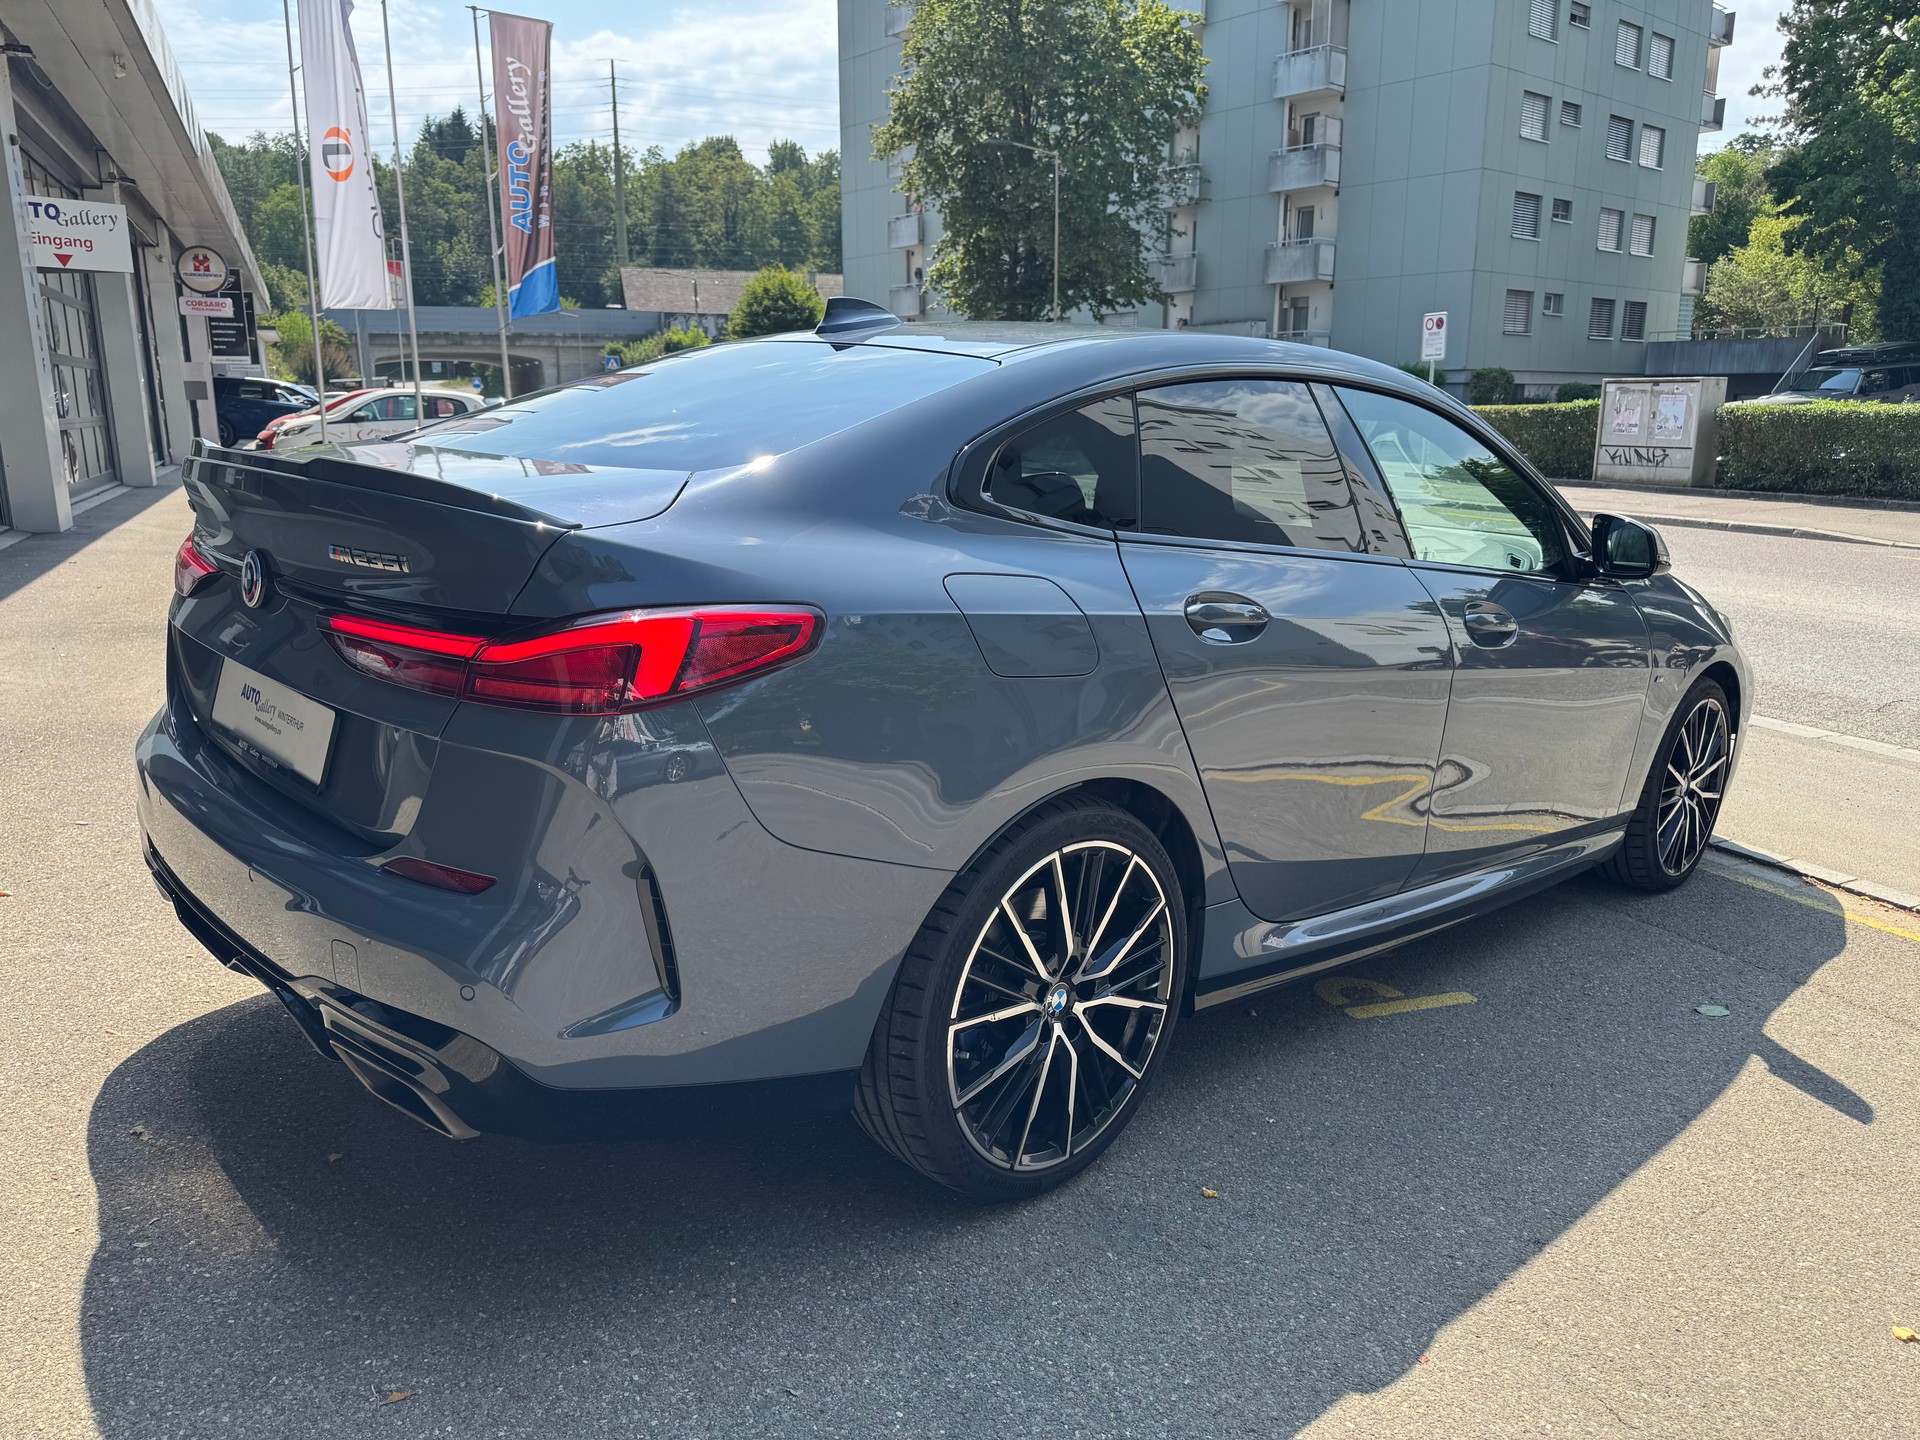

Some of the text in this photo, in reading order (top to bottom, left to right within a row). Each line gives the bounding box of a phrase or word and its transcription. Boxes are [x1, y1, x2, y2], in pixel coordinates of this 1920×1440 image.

[505, 55, 538, 235] AUTO Gallery
[28, 201, 118, 232] TO Gallery
[31, 231, 93, 252] Eingang
[185, 299, 227, 309] CORSARO
[333, 545, 410, 573] M235i
[240, 683, 304, 732] AUTO Gallery WINTERTHUR
[237, 739, 249, 751] AUTO
